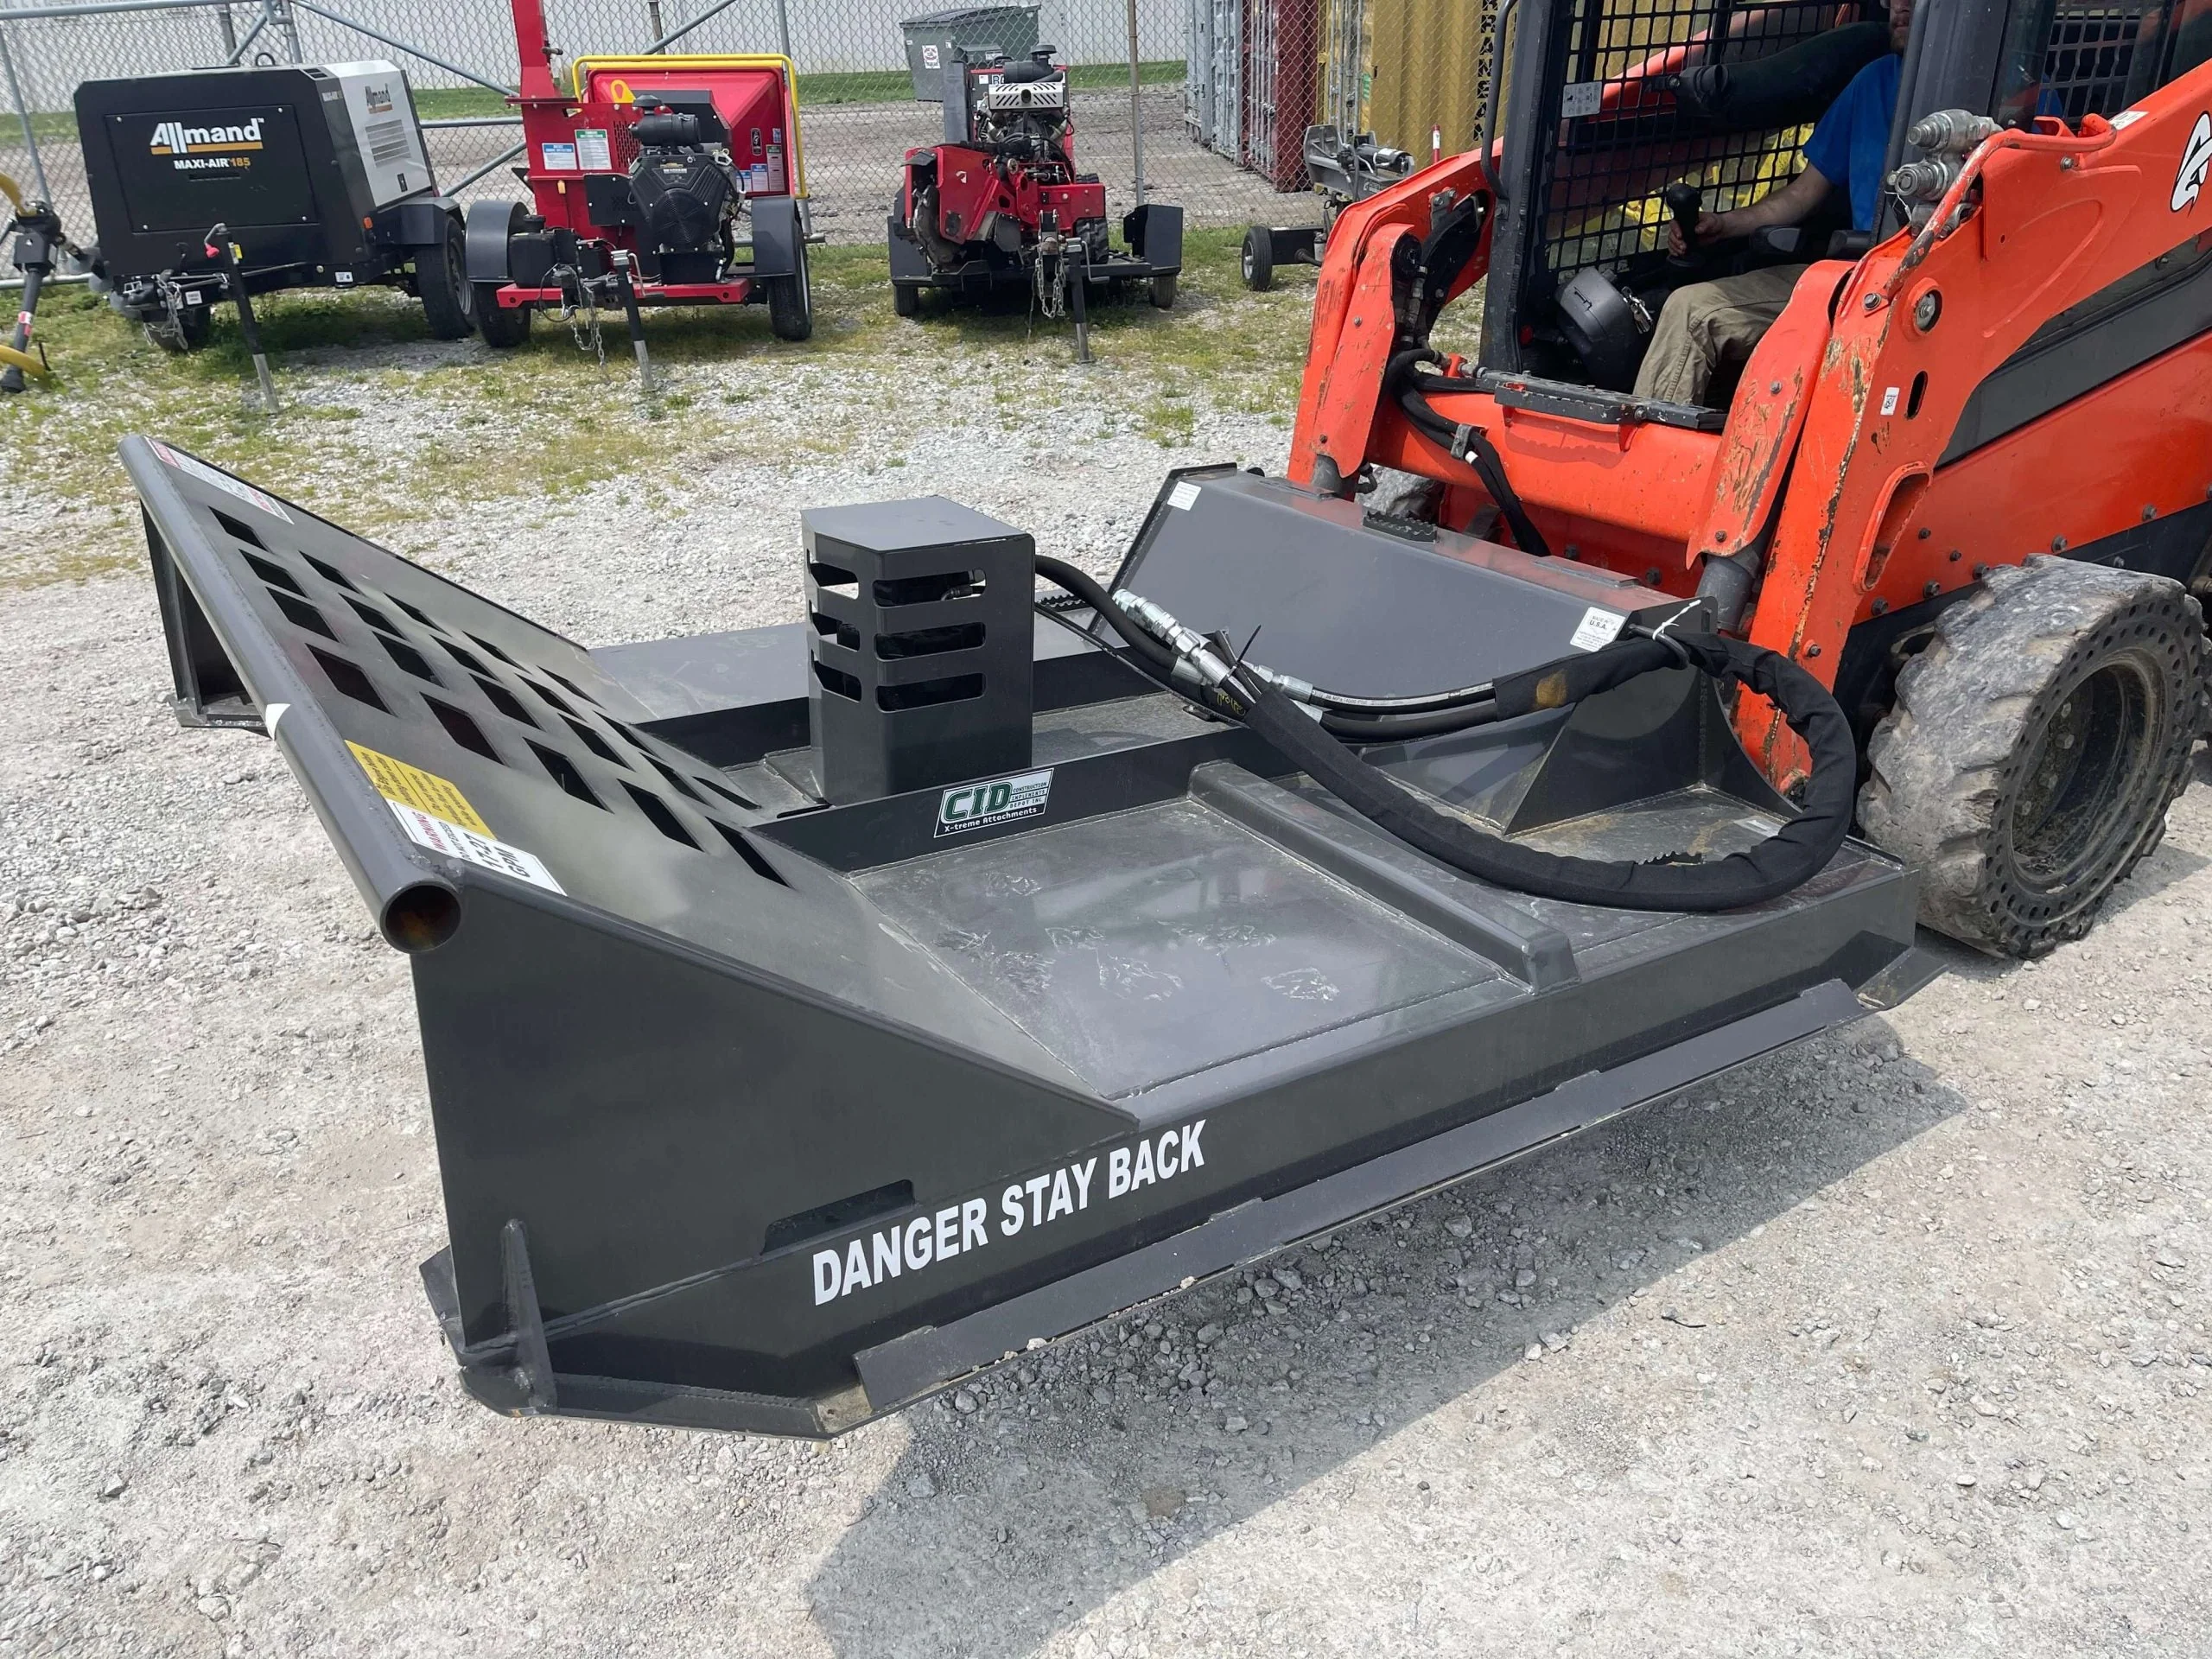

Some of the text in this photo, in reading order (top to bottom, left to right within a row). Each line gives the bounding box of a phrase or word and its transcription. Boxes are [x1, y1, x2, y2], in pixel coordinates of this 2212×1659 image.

[230, 157, 251, 167] 185
[1012, 789, 1046, 801] IMPLEMENTS
[1013, 781, 1047, 793] CONSTRUCTION
[944, 782, 1012, 821] CID
[1009, 799, 1029, 809] DEPOT
[412, 811, 448, 851] WARNING
[944, 806, 1038, 832] X-treme Attachments
[463, 832, 504, 869] 17-27
[493, 846, 531, 877] GPM
[813, 1119, 1206, 1306] DANGER STAY BACK
